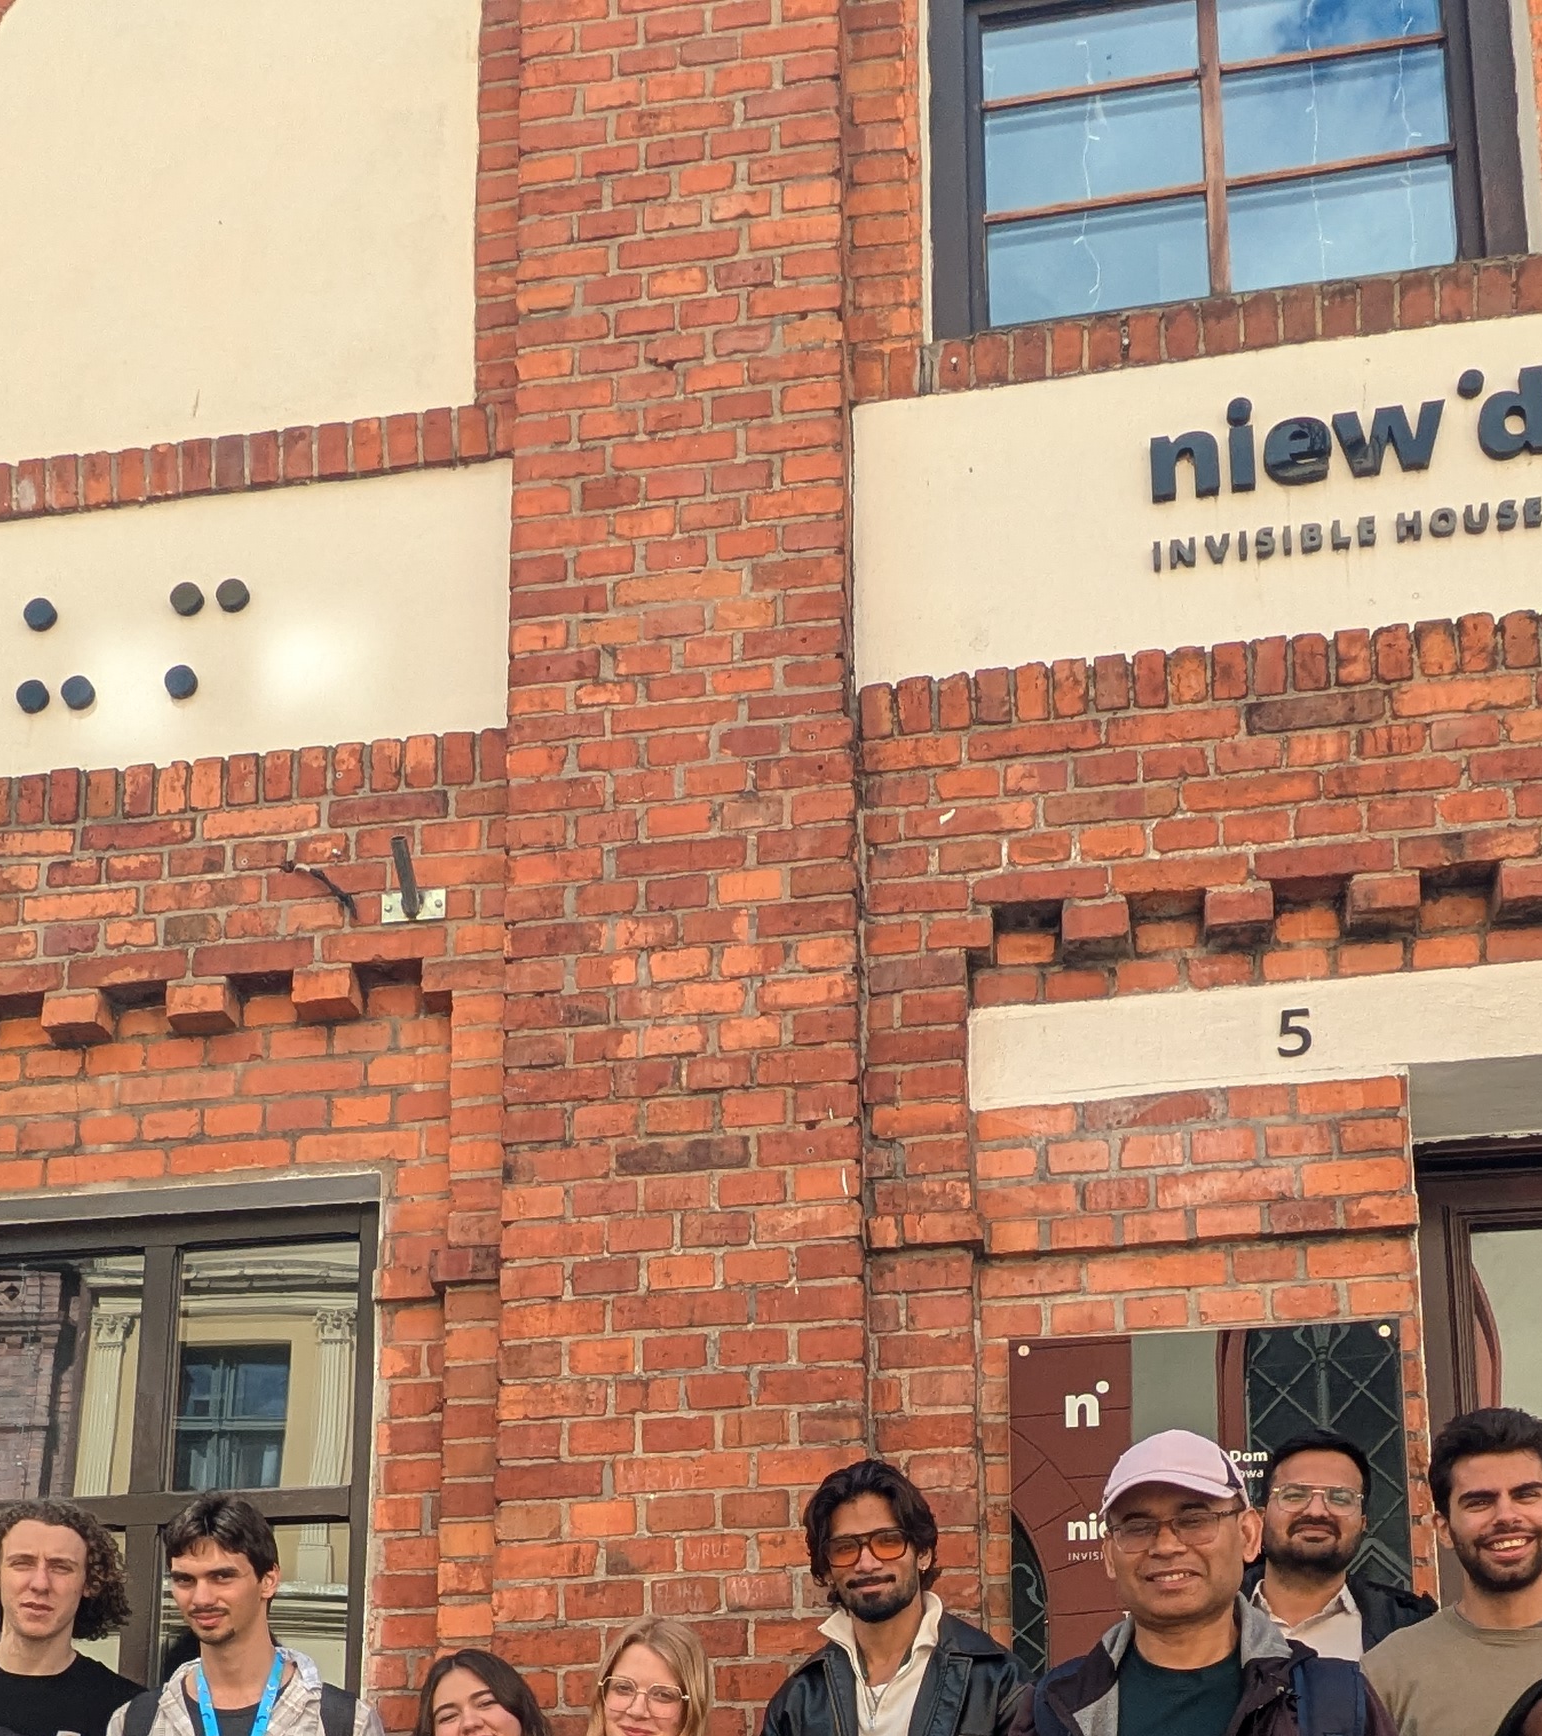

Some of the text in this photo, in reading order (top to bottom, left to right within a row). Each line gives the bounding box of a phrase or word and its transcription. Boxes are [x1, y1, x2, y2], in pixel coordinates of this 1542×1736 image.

[1152, 514, 1377, 574] INVISIBLE
[1277, 1008, 1312, 1058] 5
[1229, 1450, 1268, 1462] Dom
